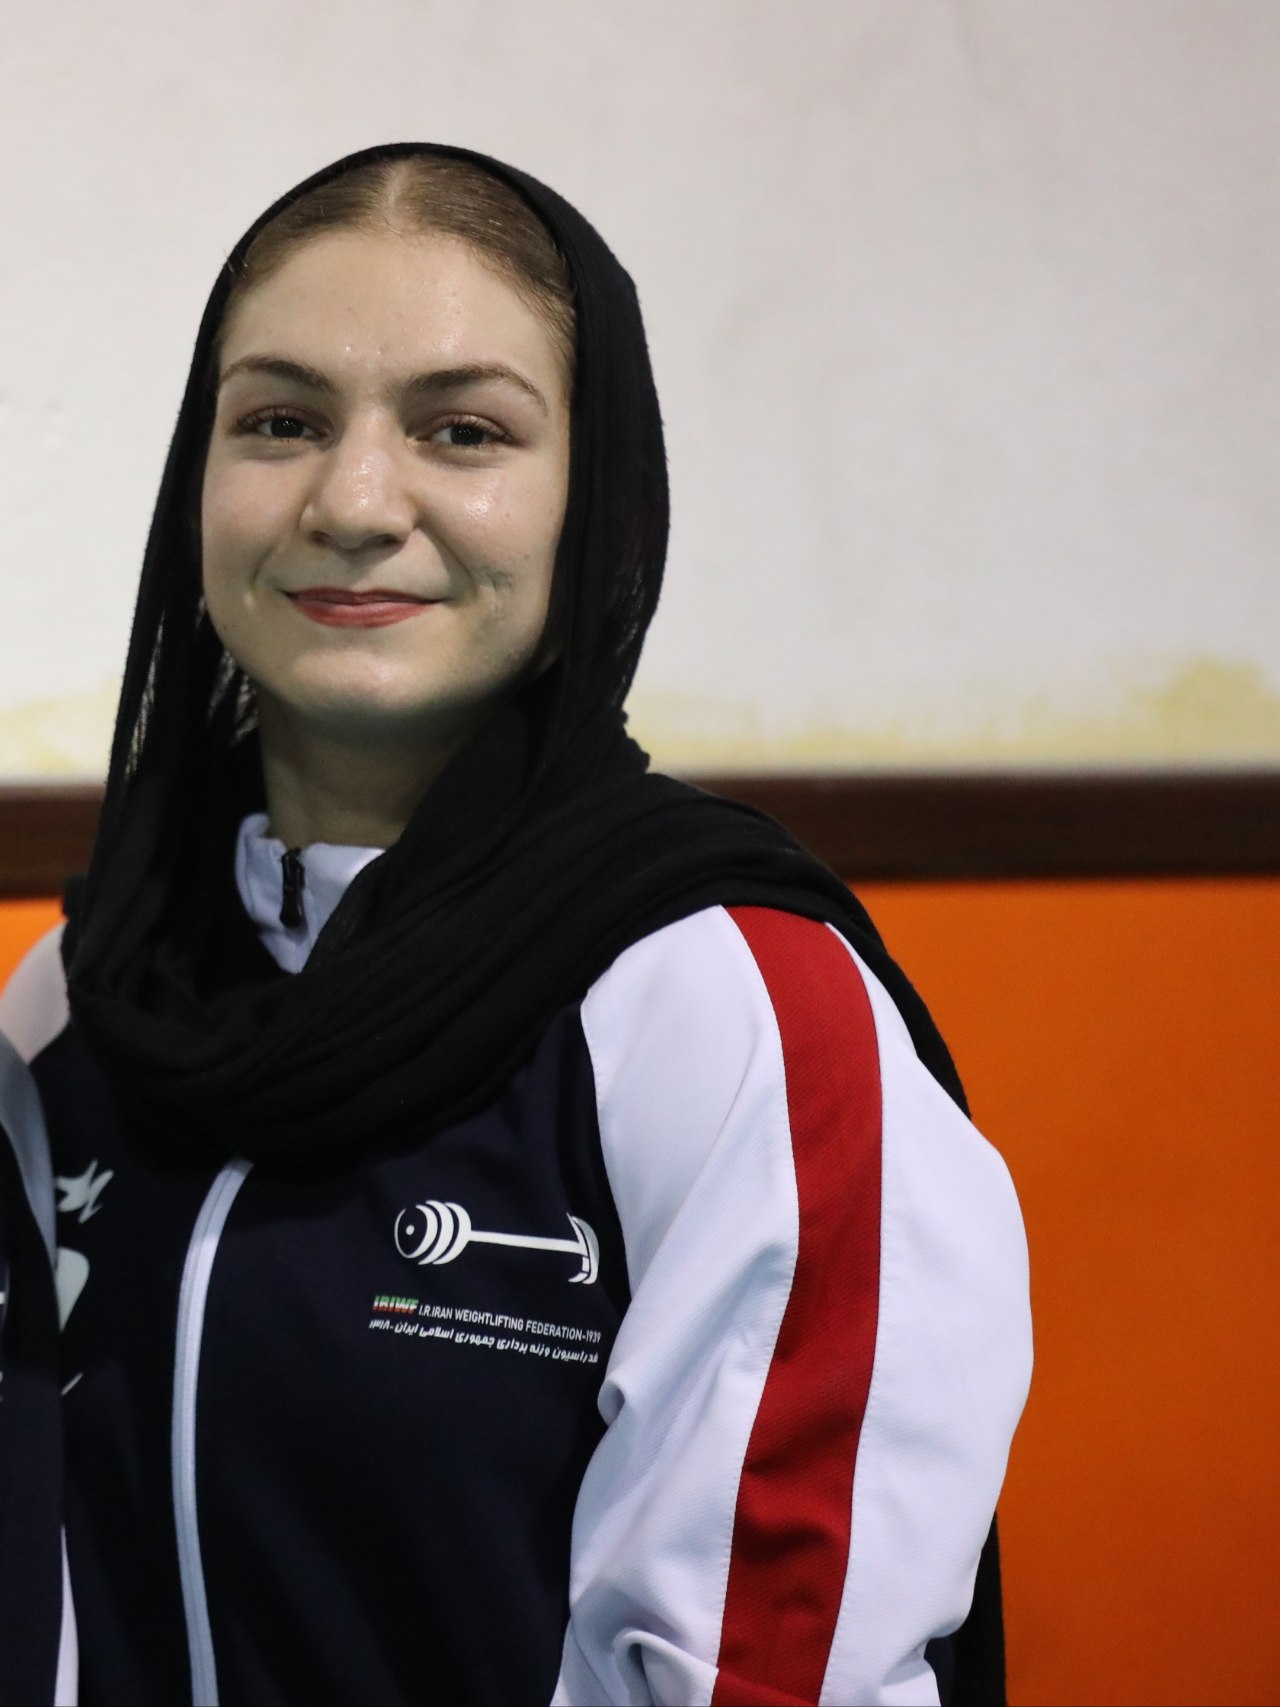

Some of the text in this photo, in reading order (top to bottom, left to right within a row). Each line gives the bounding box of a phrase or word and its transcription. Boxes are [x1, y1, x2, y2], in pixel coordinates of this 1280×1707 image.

[419, 1304, 453, 1320] I.R.IRAN
[454, 1307, 524, 1331] WEIGHTLIFTING
[419, 1325, 455, 1340] اسلامی
[454, 1331, 495, 1348] جمهوری
[496, 1338, 529, 1355] برداری
[529, 1342, 551, 1358] وزنه
[551, 1346, 599, 1364] فدراسیون
